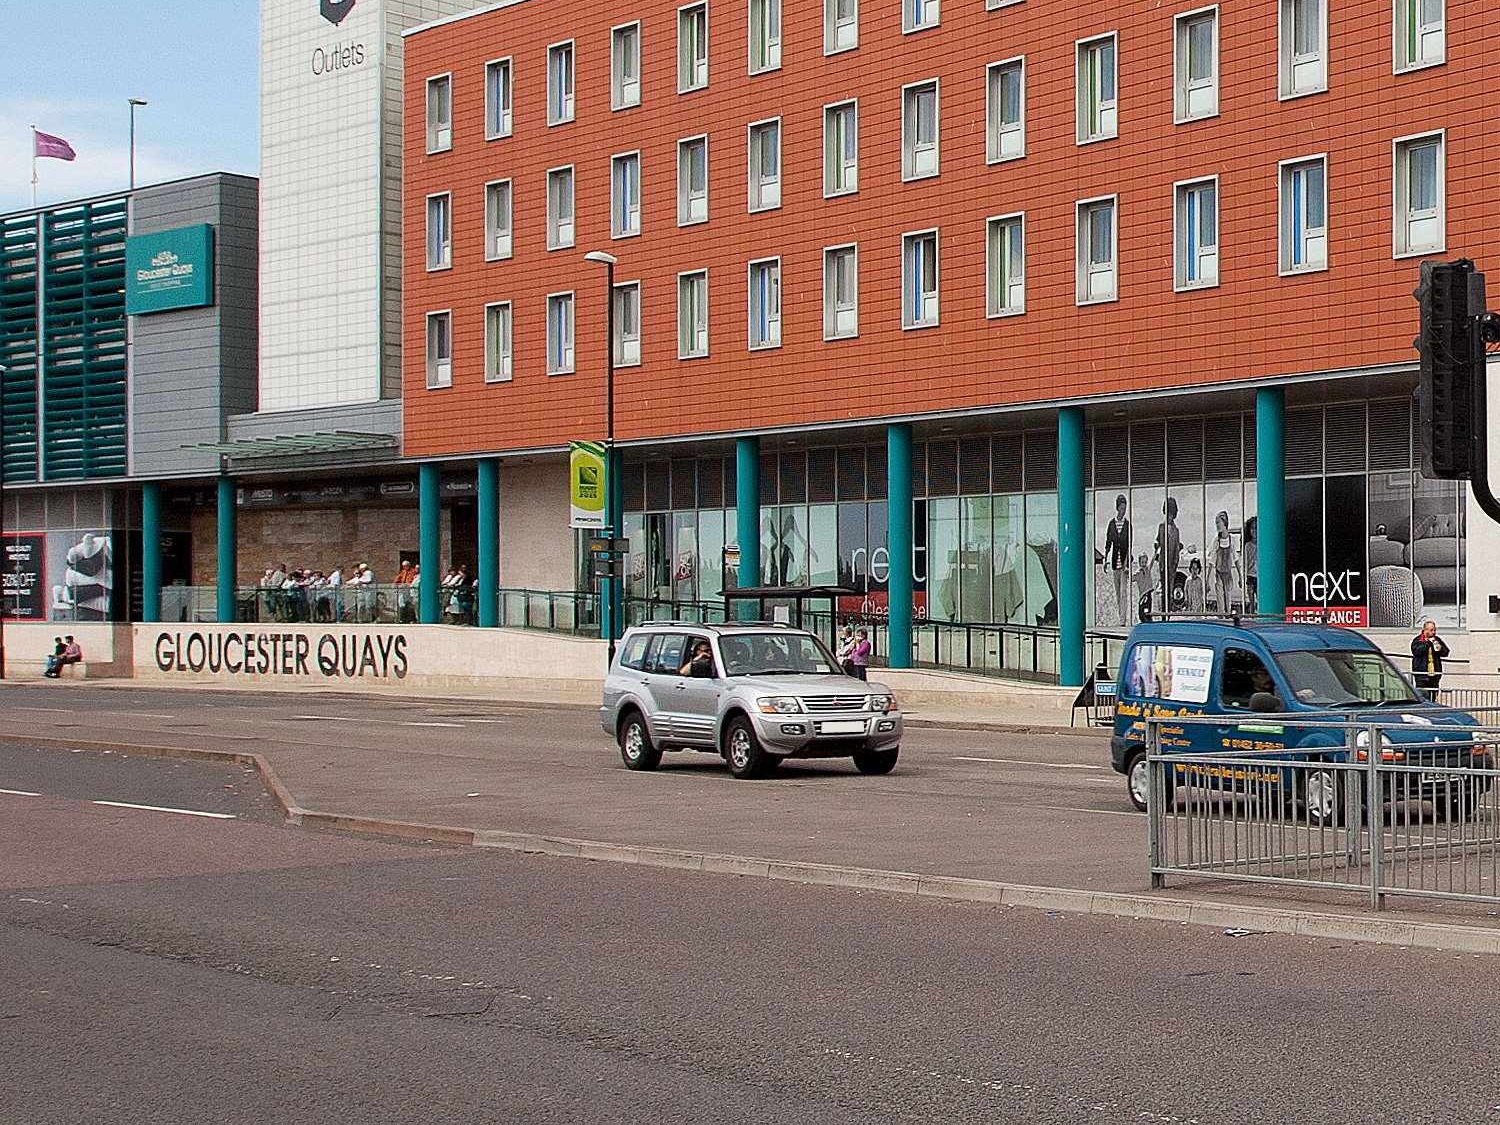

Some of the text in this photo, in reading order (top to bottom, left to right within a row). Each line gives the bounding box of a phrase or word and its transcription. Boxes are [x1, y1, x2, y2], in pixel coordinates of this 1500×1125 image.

[311, 40, 365, 76] Outlets
[851, 542, 926, 584] net
[1291, 568, 1361, 602] next
[1292, 610, 1361, 624] CLEAANCE
[155, 632, 408, 679] GLOUCESTER QUAYS
